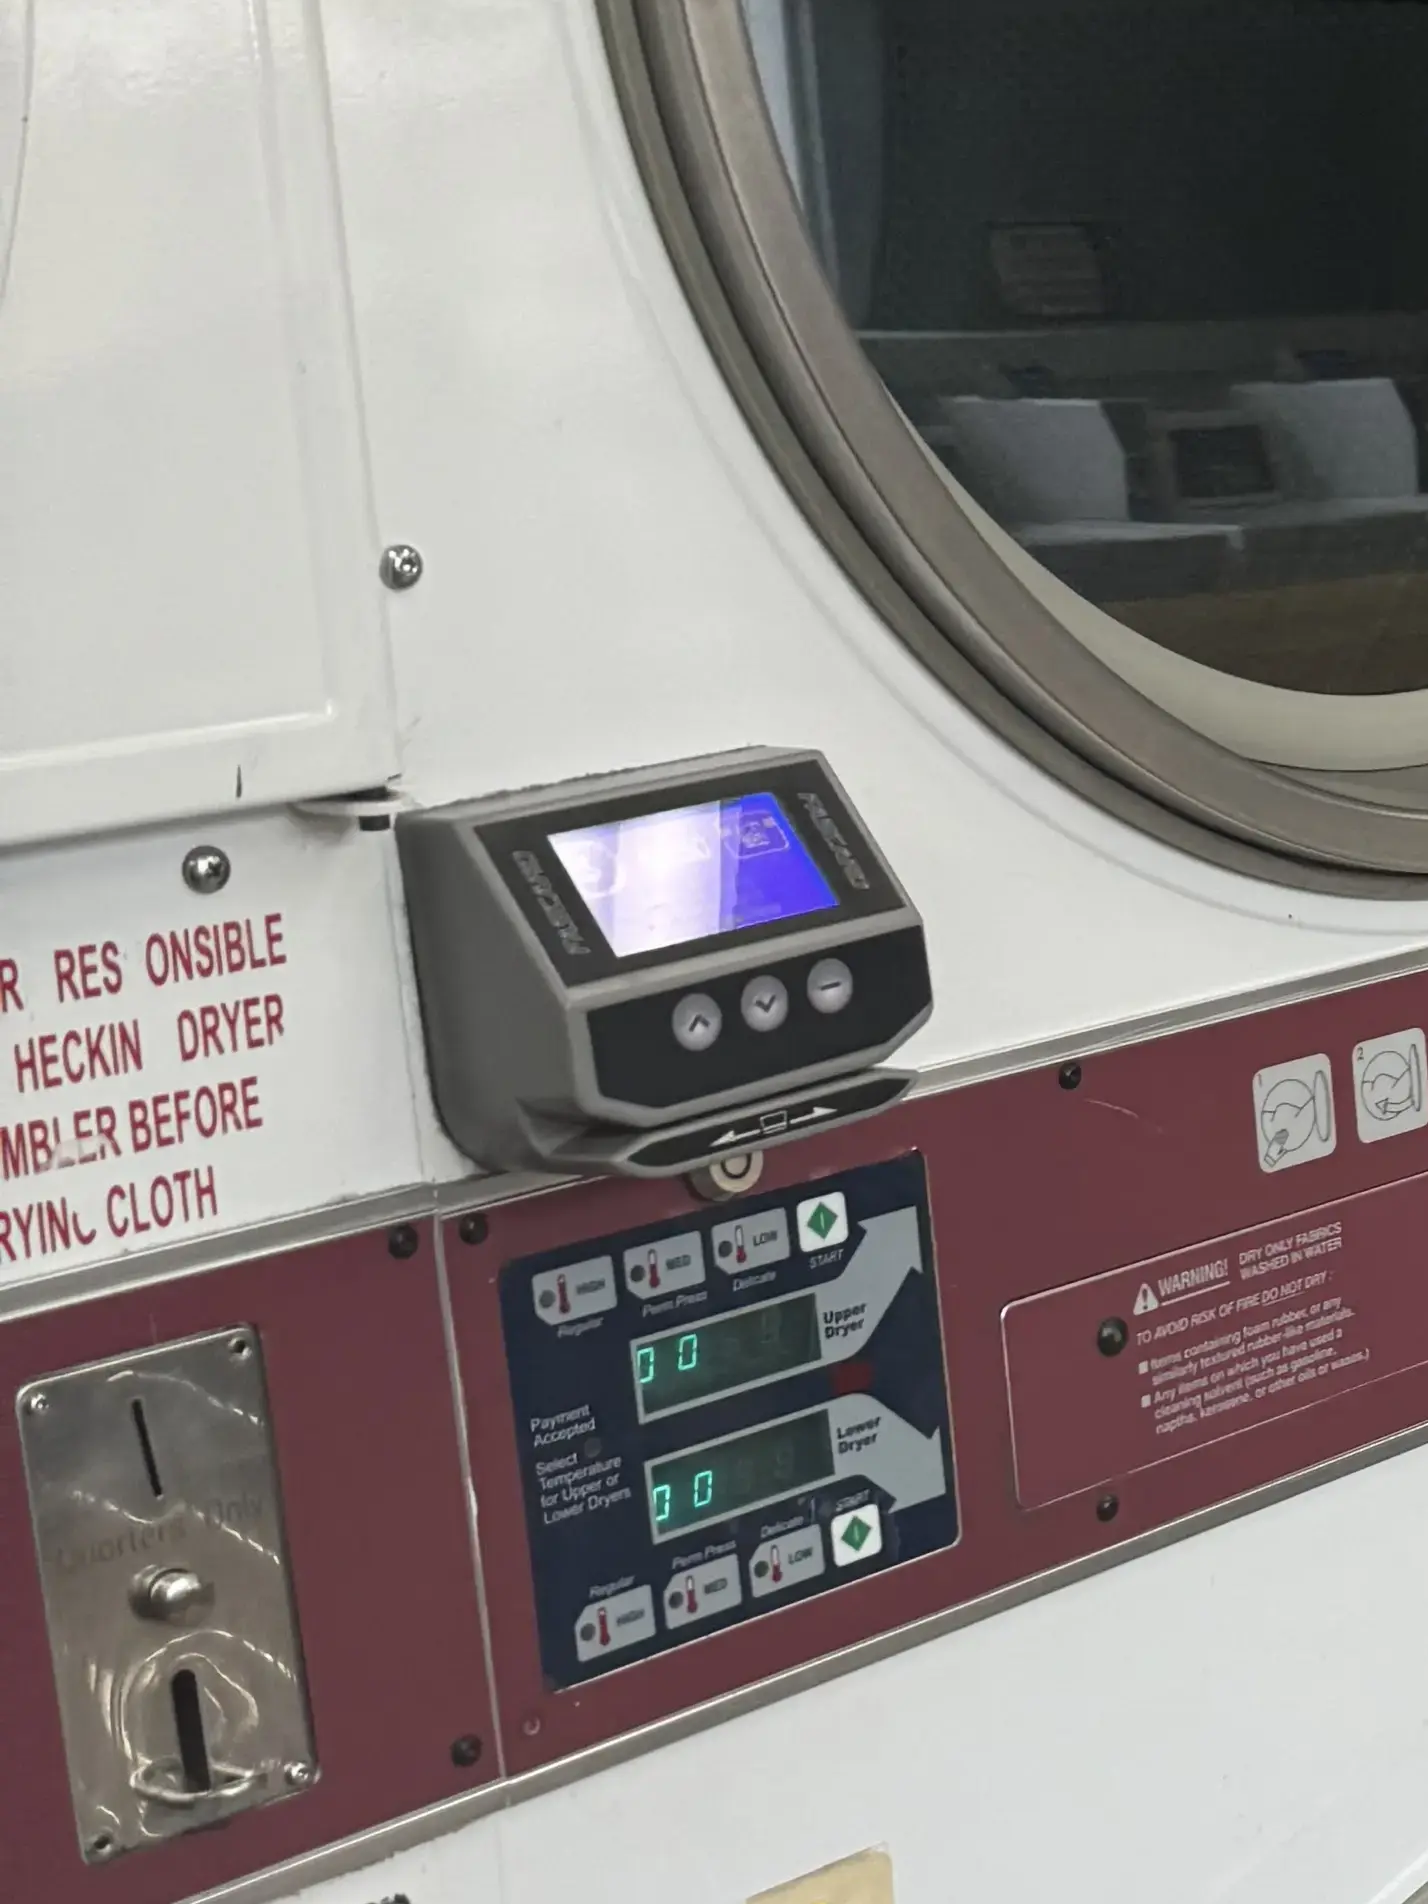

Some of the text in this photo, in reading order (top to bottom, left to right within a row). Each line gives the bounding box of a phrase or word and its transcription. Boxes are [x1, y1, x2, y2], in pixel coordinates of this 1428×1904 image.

[176, 993, 286, 1062] DRYER
[1356, 1047, 1365, 1062] 2
[128, 1075, 264, 1154] BEFORE
[106, 1164, 219, 1239] CLOTH
[752, 1230, 778, 1247] LOW
[1239, 1222, 1342, 1266] DRY ONLY FABRICS
[809, 1248, 845, 1270] START
[1240, 1237, 1342, 1280] WASHED IN WATER
[1158, 1258, 1229, 1297] WARNING!
[823, 1303, 867, 1326] Upper
[1136, 1329, 1152, 1346] TO
[1154, 1317, 1188, 1339] AVOID
[1190, 1307, 1216, 1328] RISK
[1219, 1302, 1234, 1318] OF
[1236, 1293, 1260, 1312] FIRE
[1261, 1288, 1278, 1304] DO
[1280, 1278, 1302, 1296] NOT
[824, 1319, 865, 1340] Dryer
[1153, 1388, 1176, 1405] Any
[1211, 1371, 1225, 1384] on
[1227, 1358, 1260, 1377] which
[1261, 1353, 1281, 1369] you
[1282, 1341, 1308, 1359] have
[530, 1404, 591, 1433] Payment
[533, 1417, 596, 1448] Accepted
[836, 1416, 881, 1440] Lower
[838, 1433, 878, 1454] Dryer
[535, 1453, 578, 1476] Select
[538, 1456, 623, 1491] Temperature
[540, 1473, 621, 1509] for Upper or
[543, 1501, 584, 1525] Lower
[788, 1546, 813, 1565] LOW
